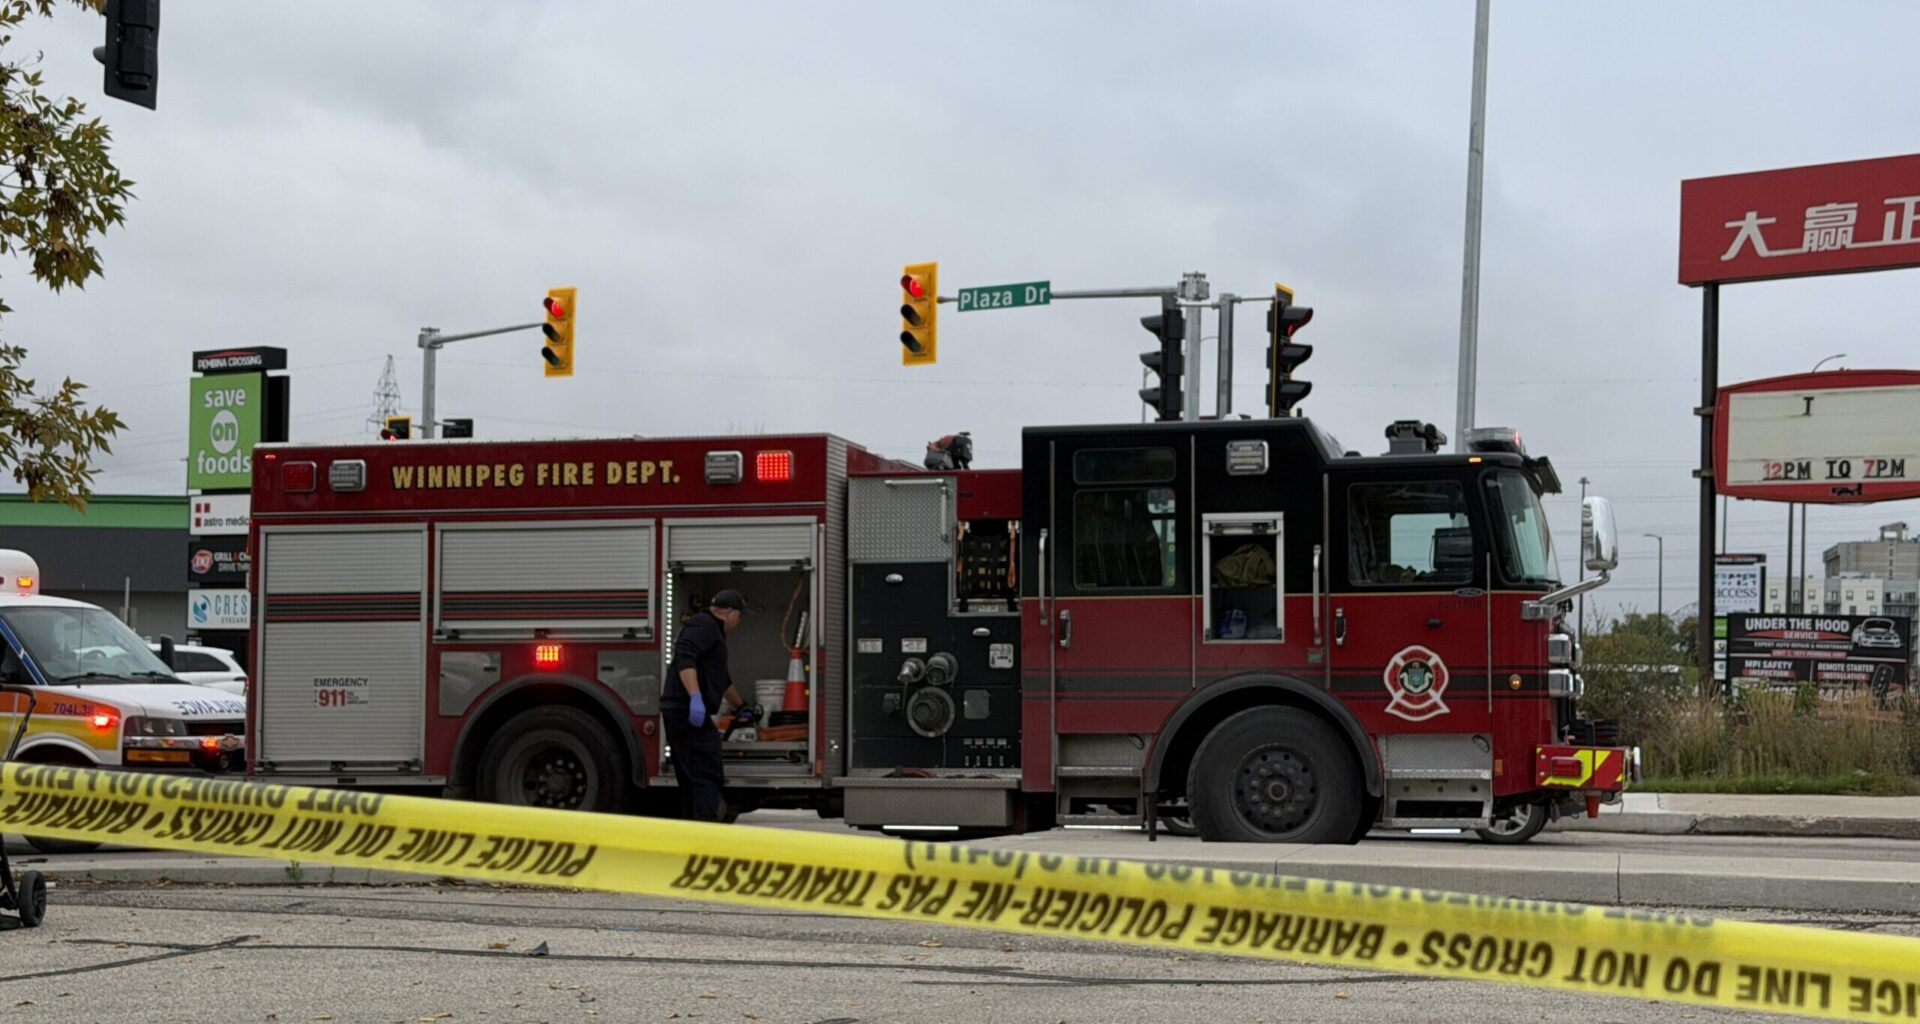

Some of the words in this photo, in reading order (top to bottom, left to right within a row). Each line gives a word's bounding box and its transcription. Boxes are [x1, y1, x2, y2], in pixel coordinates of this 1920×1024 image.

[961, 289, 1013, 310] Plaza
[1025, 286, 1047, 304] Dr
[198, 358, 227, 369] PEMBINA
[228, 355, 262, 367] CROSSING
[204, 388, 246, 408] save
[212, 422, 236, 441] on
[197, 449, 252, 474] foods
[1763, 461, 1811, 480] 12PM
[1863, 459, 1905, 478] 7PM
[392, 464, 525, 489] WINNIPEG
[536, 462, 595, 486] FIRE
[606, 460, 681, 485] DEPT.
[204, 515, 223, 527] astro
[214, 551, 232, 562] GRILL
[218, 562, 235, 573] DRIVE
[215, 594, 248, 616] CRES
[1745, 617, 1786, 632] UNDER
[1788, 618, 1813, 632] THE
[1815, 619, 1849, 633] HOOD
[1783, 631, 1819, 641] SERVICE
[1754, 641, 1774, 649] EXPERT
[1775, 642, 1790, 650] AUTO
[1791, 643, 1810, 651] REPAIR
[1744, 659, 1761, 669] MPI
[1762, 661, 1793, 670] SAFETY
[1749, 669, 1789, 678] INSPECTION
[1817, 662, 1845, 672] REMOTE
[1846, 663, 1874, 673] STARTER
[314, 677, 368, 687] EMERGENCY
[1822, 672, 1865, 681] INSTALLATION
[319, 689, 346, 707] 911
[0, 791, 149, 835] BARRAGE
[153, 806, 276, 846] CROSS
[260, 816, 344, 854] NOT
[335, 822, 397, 860] DO
[384, 827, 476, 866] LINE
[465, 835, 598, 878] POLICE
[670, 853, 877, 907] TRAVERSER
[877, 872, 957, 916] PAS
[1195, 907, 1386, 960] BARRAGE
[1415, 930, 1554, 979] CROSS
[1564, 946, 1650, 989] NOT
[1664, 956, 1722, 998] DO
[1735, 964, 1832, 1009] LINE
[1848, 976, 1920, 1019] ICE
